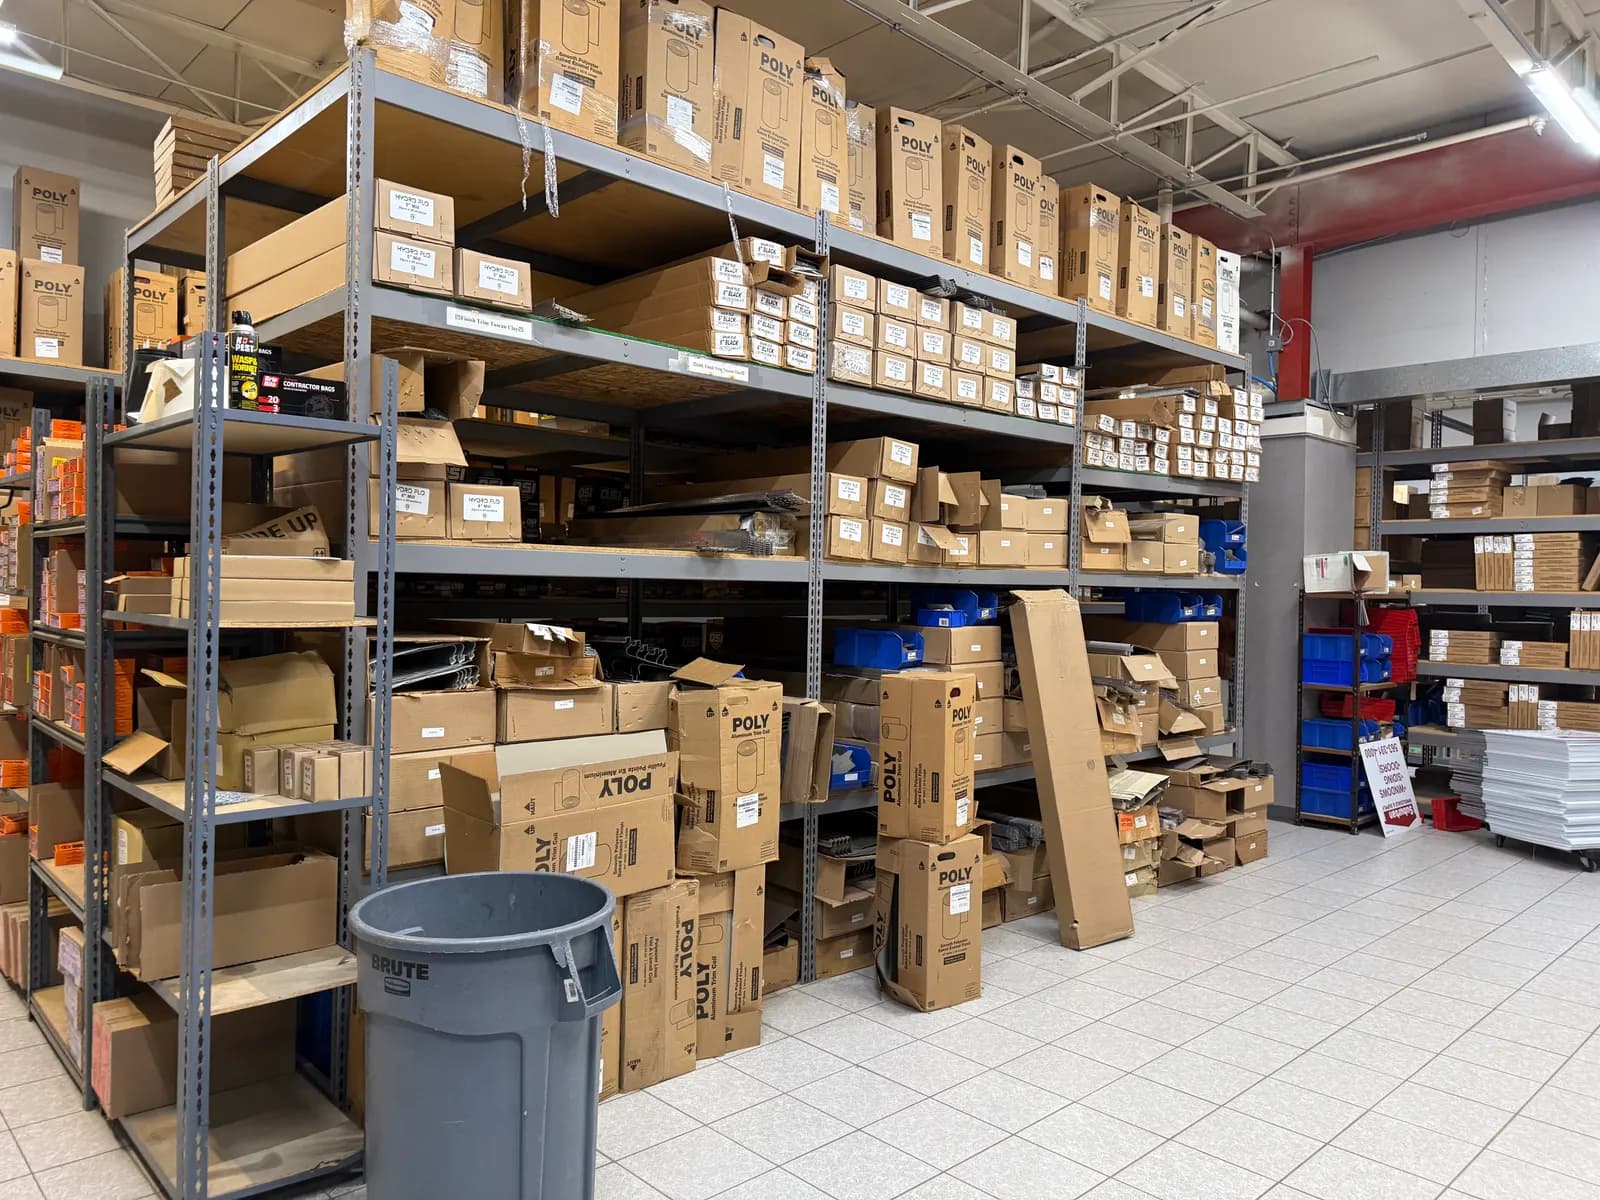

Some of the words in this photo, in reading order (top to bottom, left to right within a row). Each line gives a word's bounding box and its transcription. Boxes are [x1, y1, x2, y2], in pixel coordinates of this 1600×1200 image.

[761, 52, 794, 79] POLY
[812, 85, 839, 109] POLY
[901, 135, 932, 154] POLY
[966, 155, 986, 175] POLY
[1013, 172, 1036, 191] POLY
[32, 187, 67, 202] POLY
[1040, 199, 1055, 213] OLY
[1096, 207, 1116, 223] POLY
[1137, 225, 1155, 240] POLY
[763, 246, 776, 254] BLACK
[1173, 243, 1188, 256] POLY
[34, 280, 72, 293] POLY
[134, 287, 167, 301] POLY
[728, 290, 742, 298] BLACK
[235, 343, 254, 352] PEST
[231, 363, 257, 373] HORNET
[283, 380, 320, 391] CONTRACTOR
[321, 384, 335, 392] BAGS
[268, 395, 279, 404] 20
[273, 404, 278, 412] 3
[287, 512, 318, 533] UP
[952, 706, 972, 722] POLY
[732, 713, 770, 732] POLY
[1379, 762, 1399, 774] DOORS
[883, 752, 896, 803] POLY
[1383, 773, 1401, 785] SIDING
[599, 772, 652, 799] POLY
[1388, 805, 1414, 819] Suburban
[939, 866, 973, 885] POLY
[875, 910, 884, 947] OLY
[679, 918, 695, 978] POLY
[371, 953, 430, 981] BRUTE
[696, 962, 710, 1020] POLY
